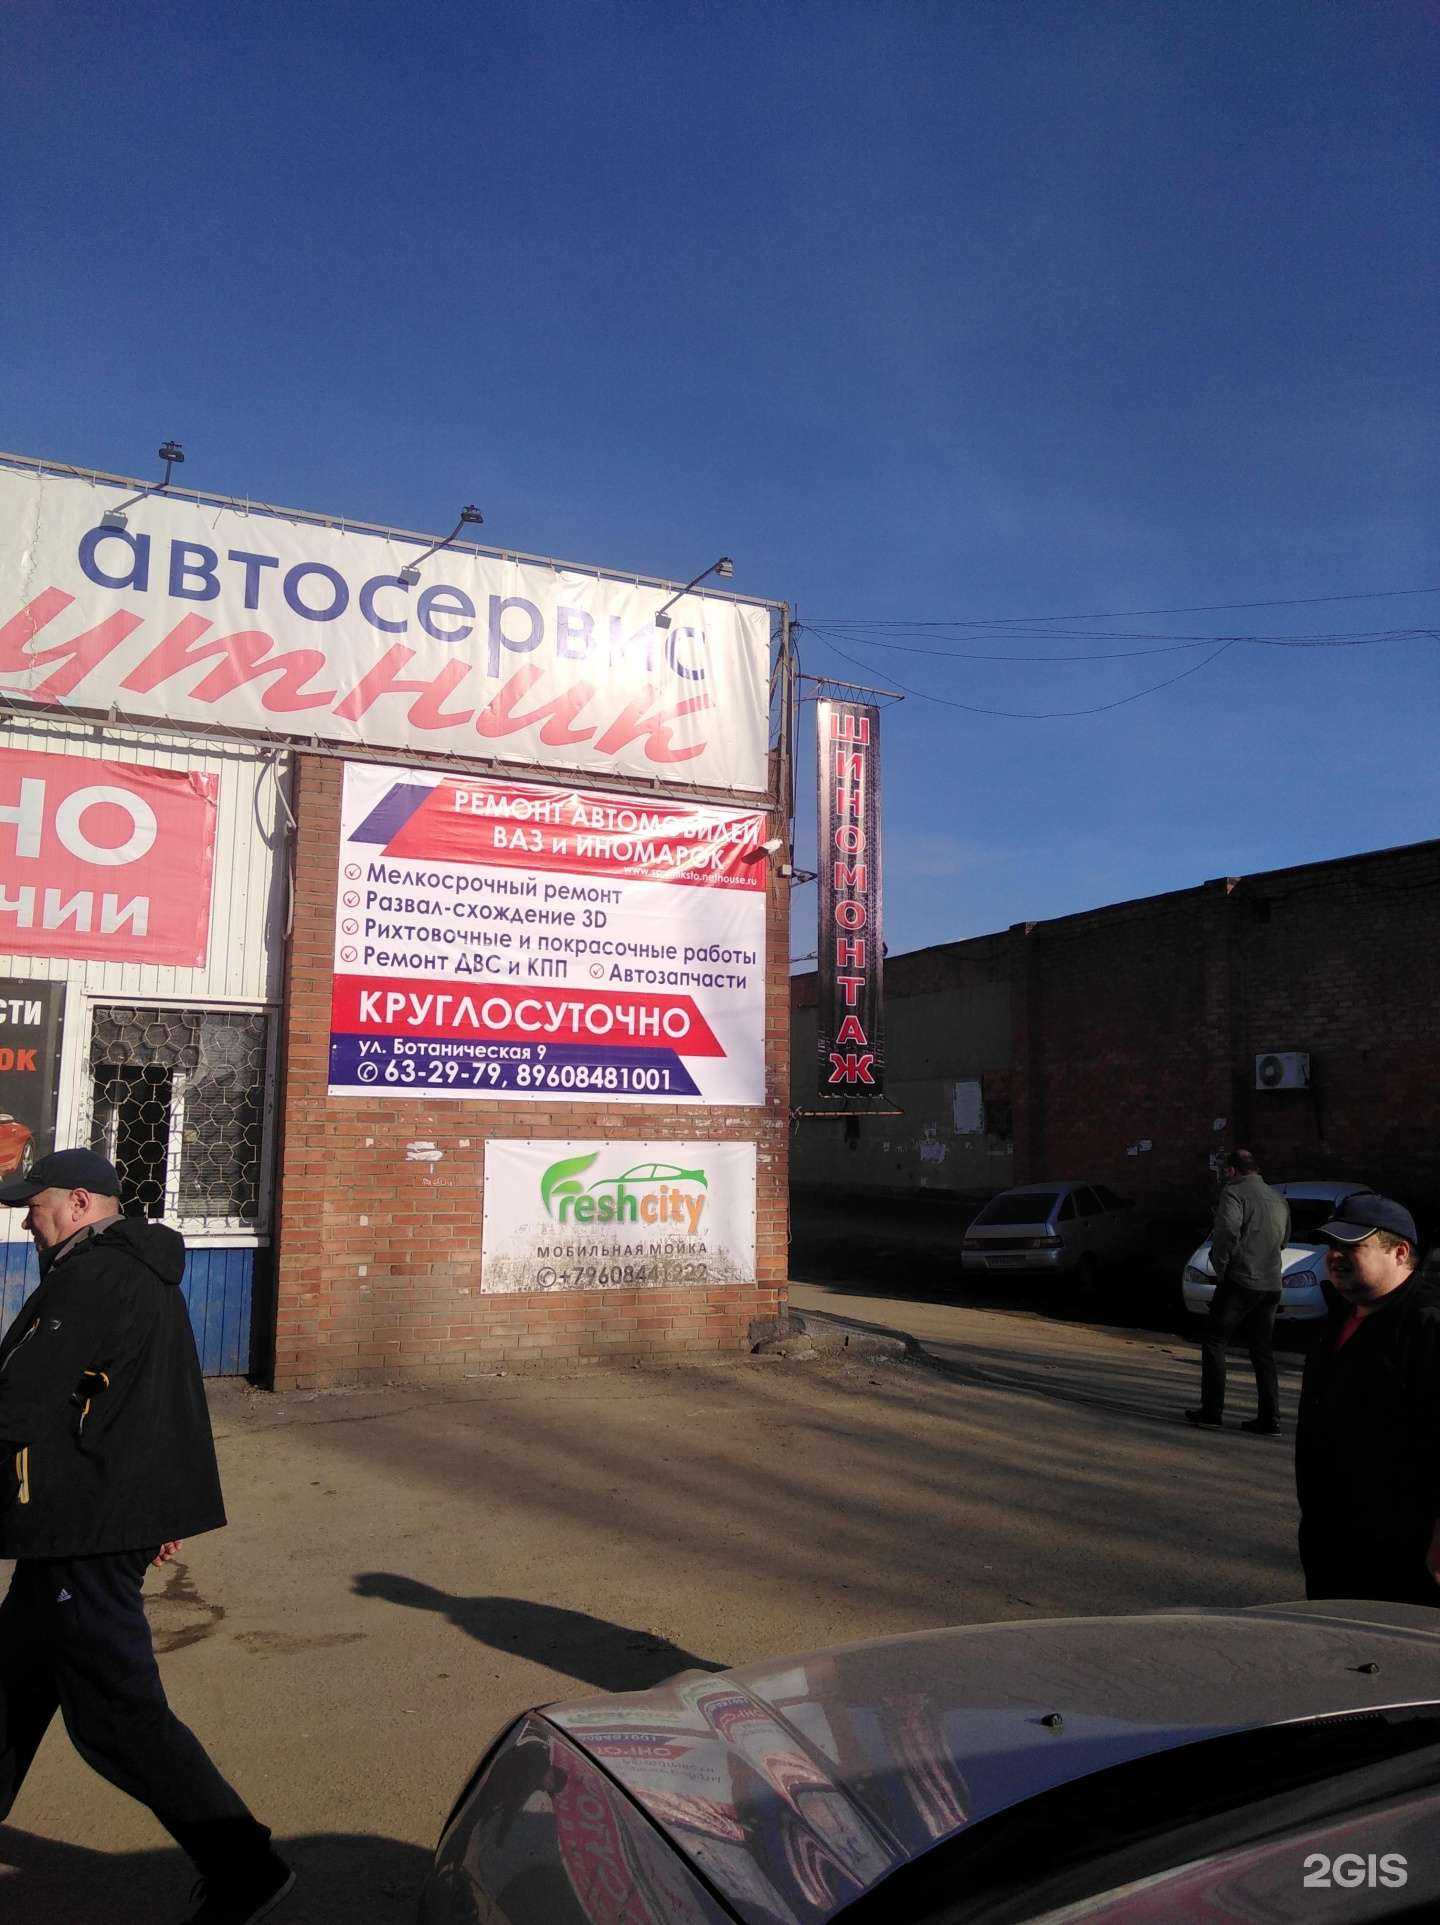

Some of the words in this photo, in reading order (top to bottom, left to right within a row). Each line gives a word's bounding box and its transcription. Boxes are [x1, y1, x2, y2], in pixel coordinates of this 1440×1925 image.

[78, 524, 709, 682] автосервис
[454, 791, 564, 825] РЕМОНТ
[493, 826, 544, 853] ВАЗ
[551, 838, 568, 855] и
[576, 835, 726, 871] ИНОМАРОК
[366, 863, 538, 897] Мелкосрочный
[543, 884, 623, 905] ремонт
[828, 712, 877, 1085] ШИНОМОНТАЖ
[366, 890, 576, 926] Развал-схождение
[582, 909, 607, 928] 3D
[365, 918, 512, 949] Рихтовочные
[519, 934, 531, 949] и
[538, 936, 677, 960] покрасочные
[683, 944, 757, 965] работы
[364, 946, 449, 970] Ремонт
[454, 953, 501, 975] ДВС
[509, 960, 520, 975] и
[527, 957, 568, 978] КПП
[609, 963, 747, 990] Автозапчасти
[359, 991, 691, 1038] КРУГЛОСУТОЧНО
[358, 1040, 387, 1056] ул.
[393, 1038, 531, 1060] Ботаническая
[537, 1045, 547, 1060] 9
[384, 1060, 509, 1089] 63-29-79,
[516, 1064, 672, 1091] 89608481001
[537, 1244, 643, 1258] МОБИЛЬНАЯ
[650, 1241, 707, 1255] МОЙКА
